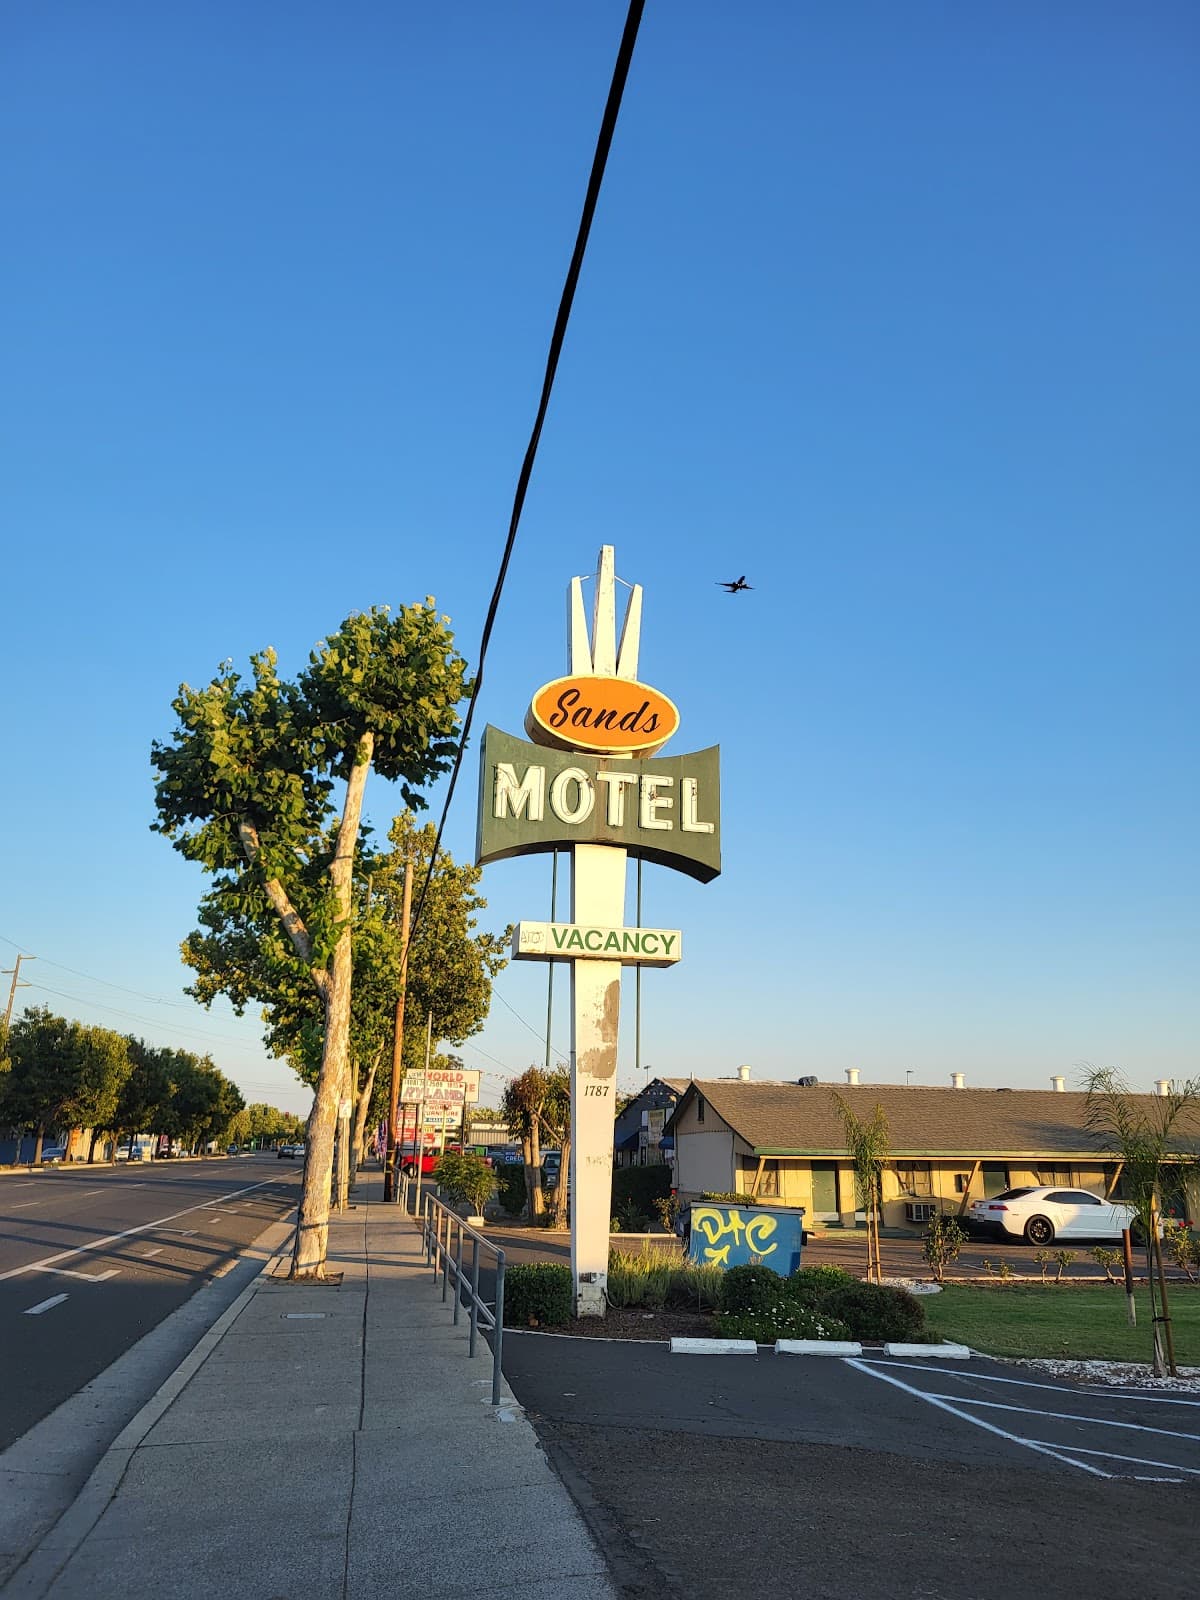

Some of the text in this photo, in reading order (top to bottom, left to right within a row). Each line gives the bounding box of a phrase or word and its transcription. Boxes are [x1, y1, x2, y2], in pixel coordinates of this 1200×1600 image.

[550, 688, 660, 734] Sands
[494, 762, 716, 834] MOTEL
[551, 927, 676, 955] VACANCY
[584, 1085, 610, 1097] 1787
